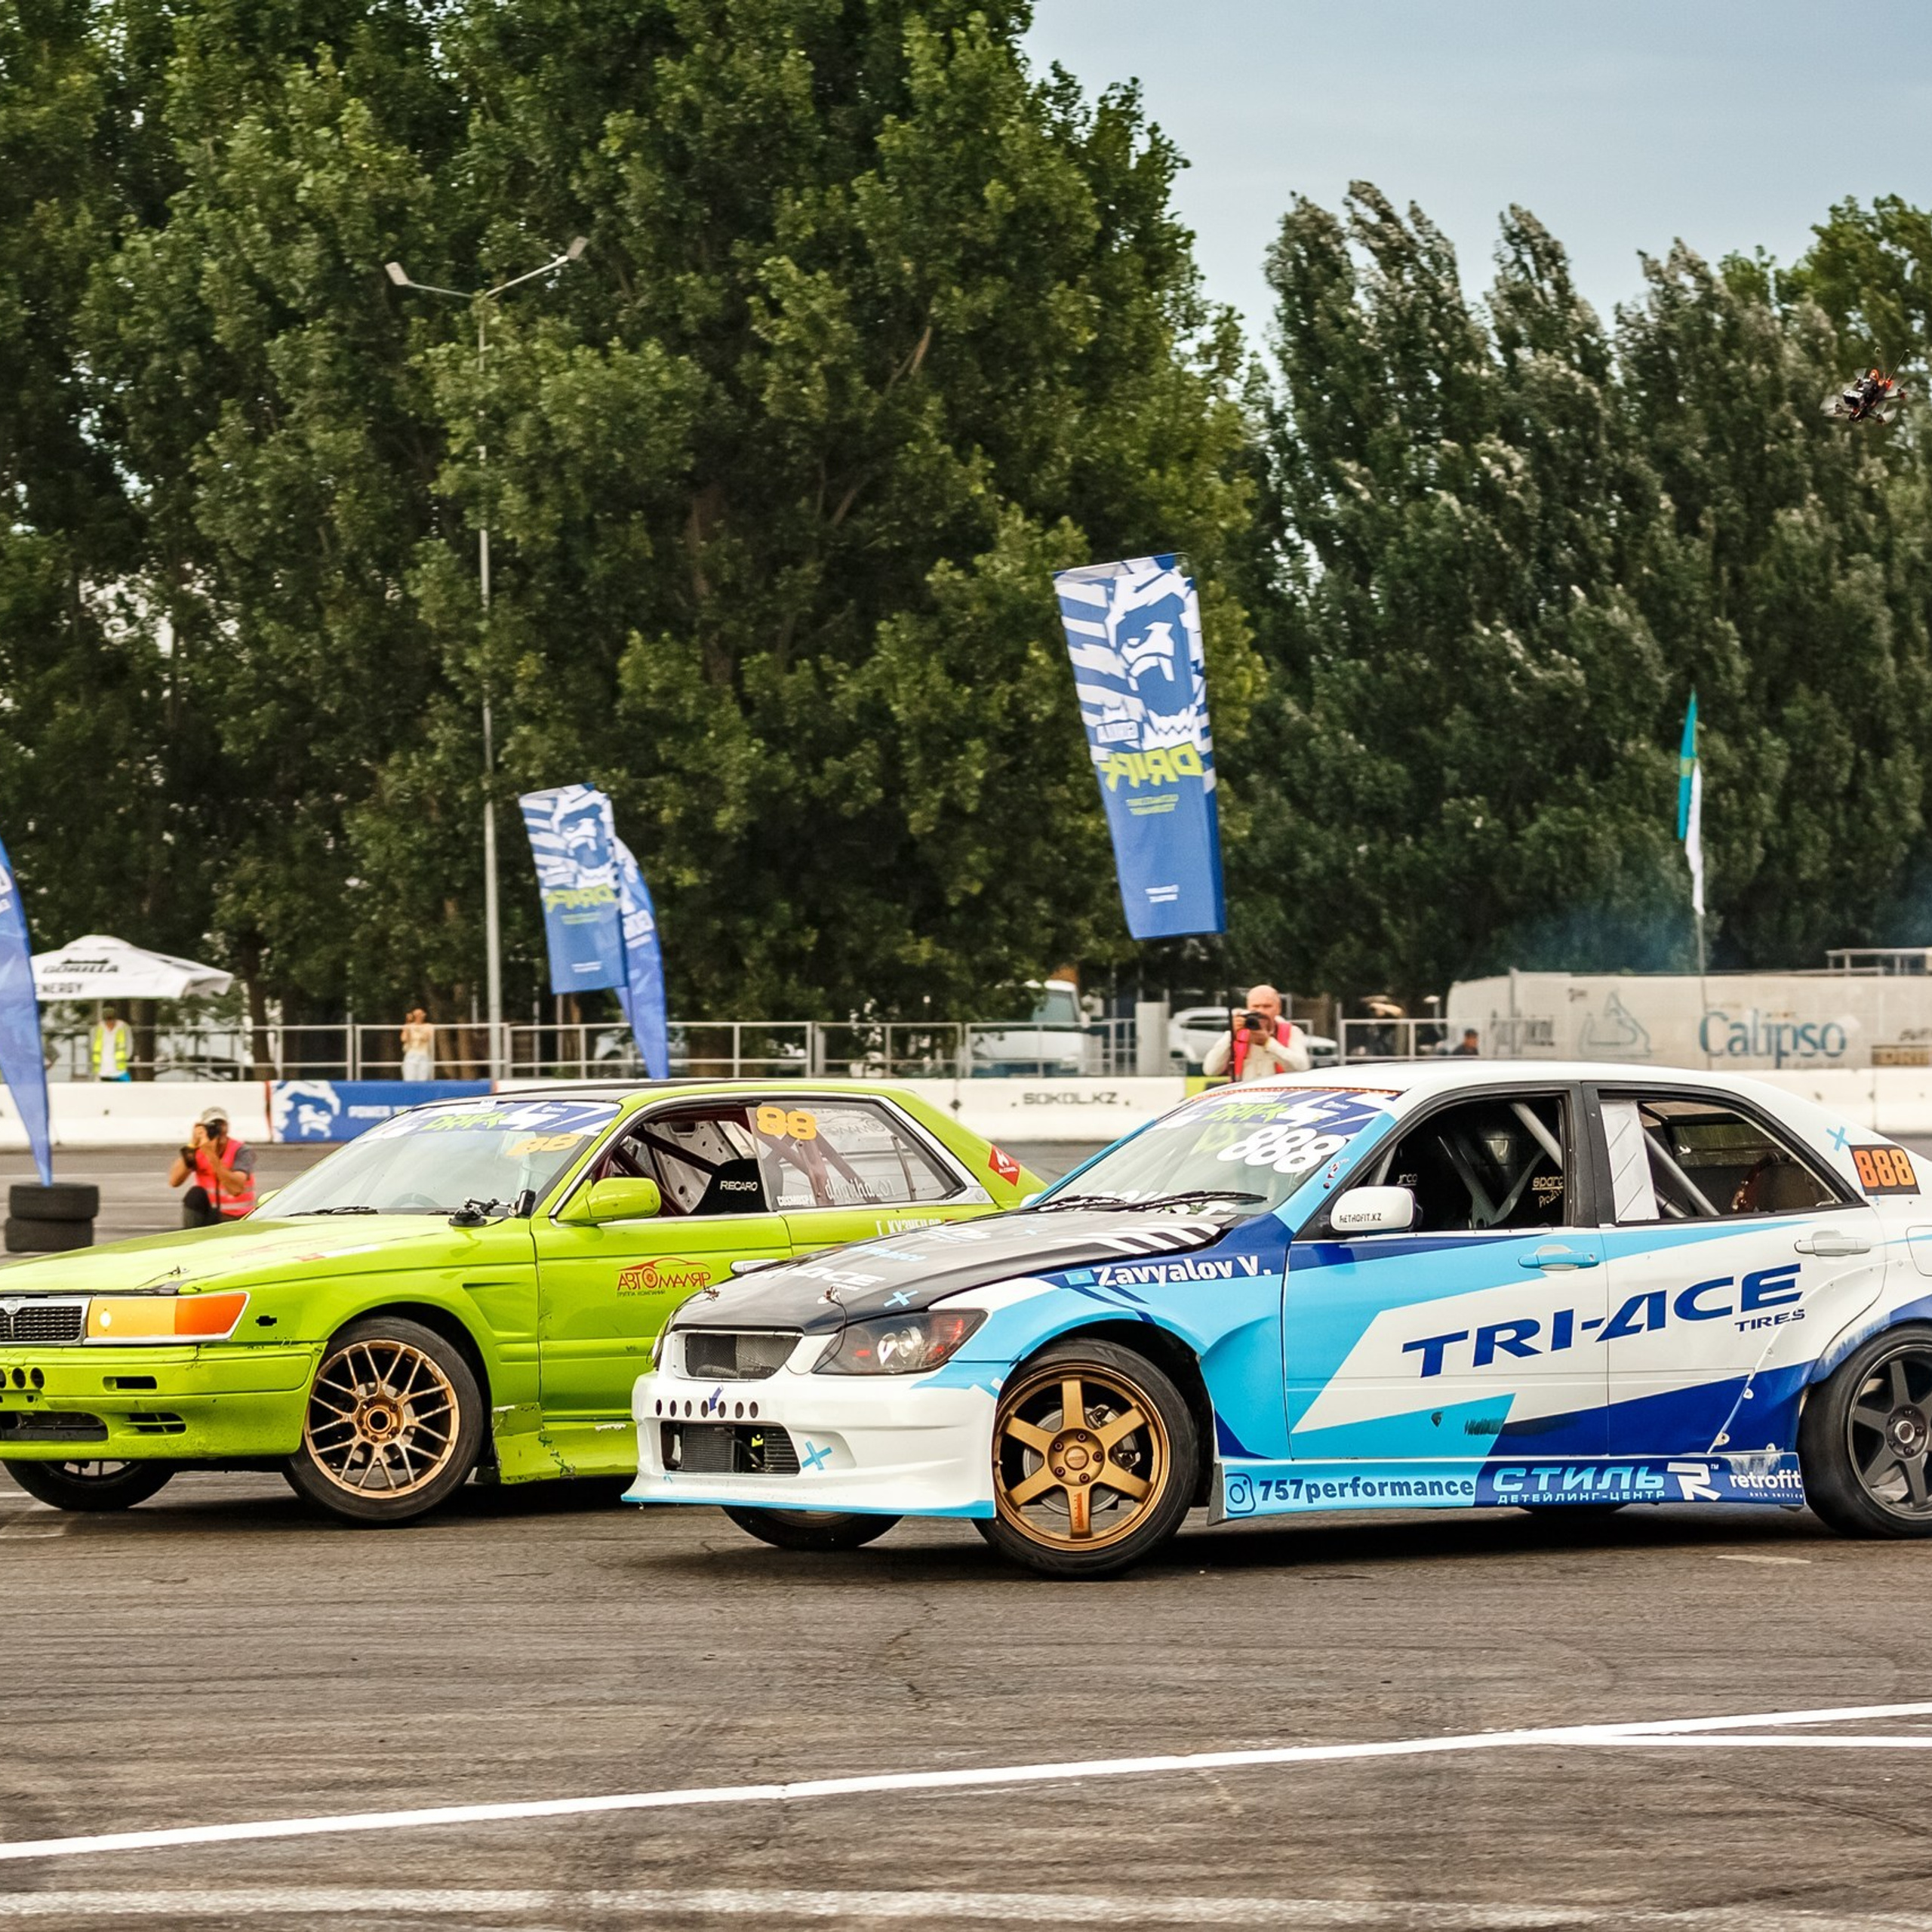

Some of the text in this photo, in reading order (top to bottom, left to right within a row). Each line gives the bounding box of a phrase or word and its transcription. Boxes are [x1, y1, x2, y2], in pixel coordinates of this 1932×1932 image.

[1700, 1008, 1847, 1069] Calipso
[757, 1106, 817, 1140] 88
[1217, 1124, 1346, 1173] 888
[1854, 1149, 1915, 1187] 888
[720, 1180, 758, 1192] RECARO
[1533, 1177, 1563, 1189] sparc
[1093, 1255, 1272, 1286] Zavyalov V.
[1402, 1263, 1803, 1378] TRI-ACE
[1735, 1309, 1805, 1332] TIRES
[1259, 1477, 1474, 1503] 757performance
[1493, 1466, 1665, 1492] СТИЛЬ
[1729, 1469, 1803, 1489] retrofit
[1497, 1490, 1666, 1504] ДЕТЕЙЛИНГ-ЦЕНТР
